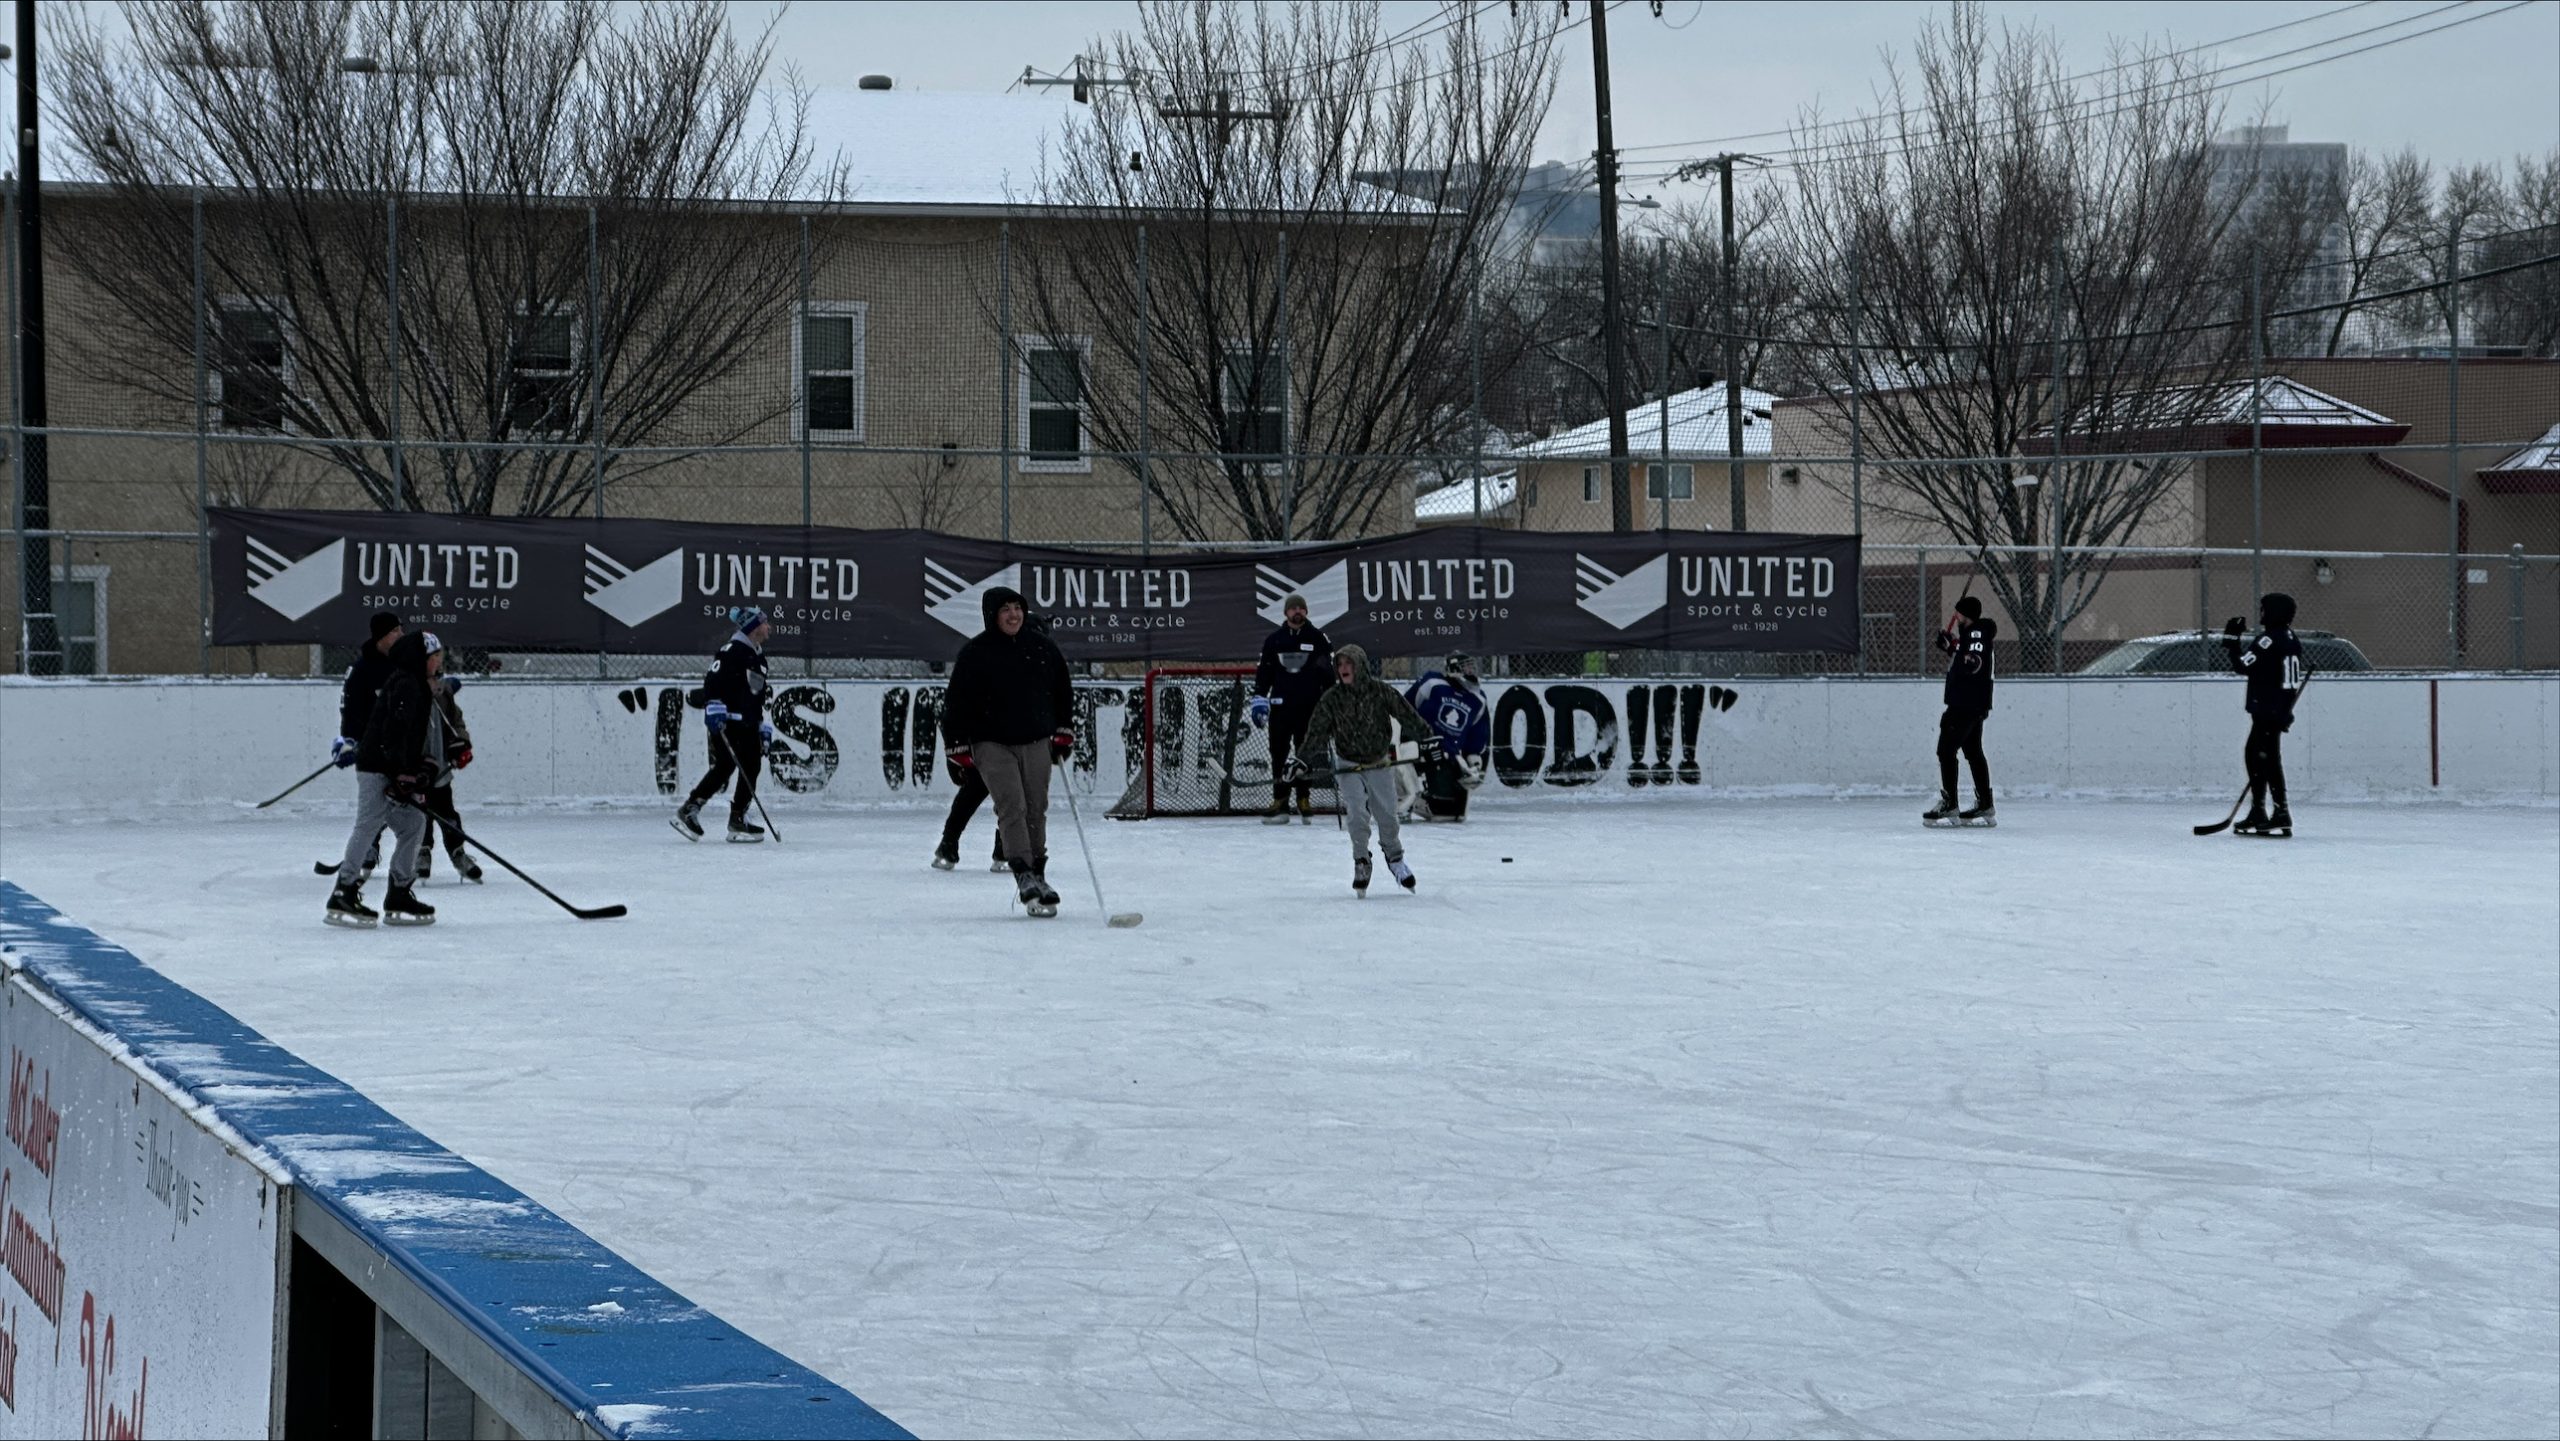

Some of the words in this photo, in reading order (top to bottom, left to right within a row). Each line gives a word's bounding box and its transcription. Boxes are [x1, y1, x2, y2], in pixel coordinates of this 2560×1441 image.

[362, 593, 420, 609] sport
[430, 593, 443, 608] &
[454, 595, 511, 612] cycle
[1687, 604, 1741, 619] sport
[1751, 603, 1763, 616] &
[1774, 603, 1828, 619] cycle
[409, 614, 429, 624] est.
[433, 613, 457, 624] 1928
[772, 604, 785, 619] &
[796, 607, 852, 622] cycle
[1052, 614, 1097, 630] port
[1108, 614, 1120, 628] &
[1131, 613, 1186, 629] cycle
[1369, 607, 1423, 624] sport
[1434, 606, 1446, 620] &
[1456, 605, 1509, 622] cycle
[776, 625, 801, 635] 1928
[1414, 627, 1433, 636] est.
[1437, 625, 1461, 636] 1928
[1755, 622, 1779, 632] 1928
[1087, 634, 1108, 643] est.
[1112, 633, 1136, 643] 1928
[2282, 655, 2300, 690] 10
[5, 1043, 60, 1218] McCauley
[0, 1167, 66, 1368] Community
